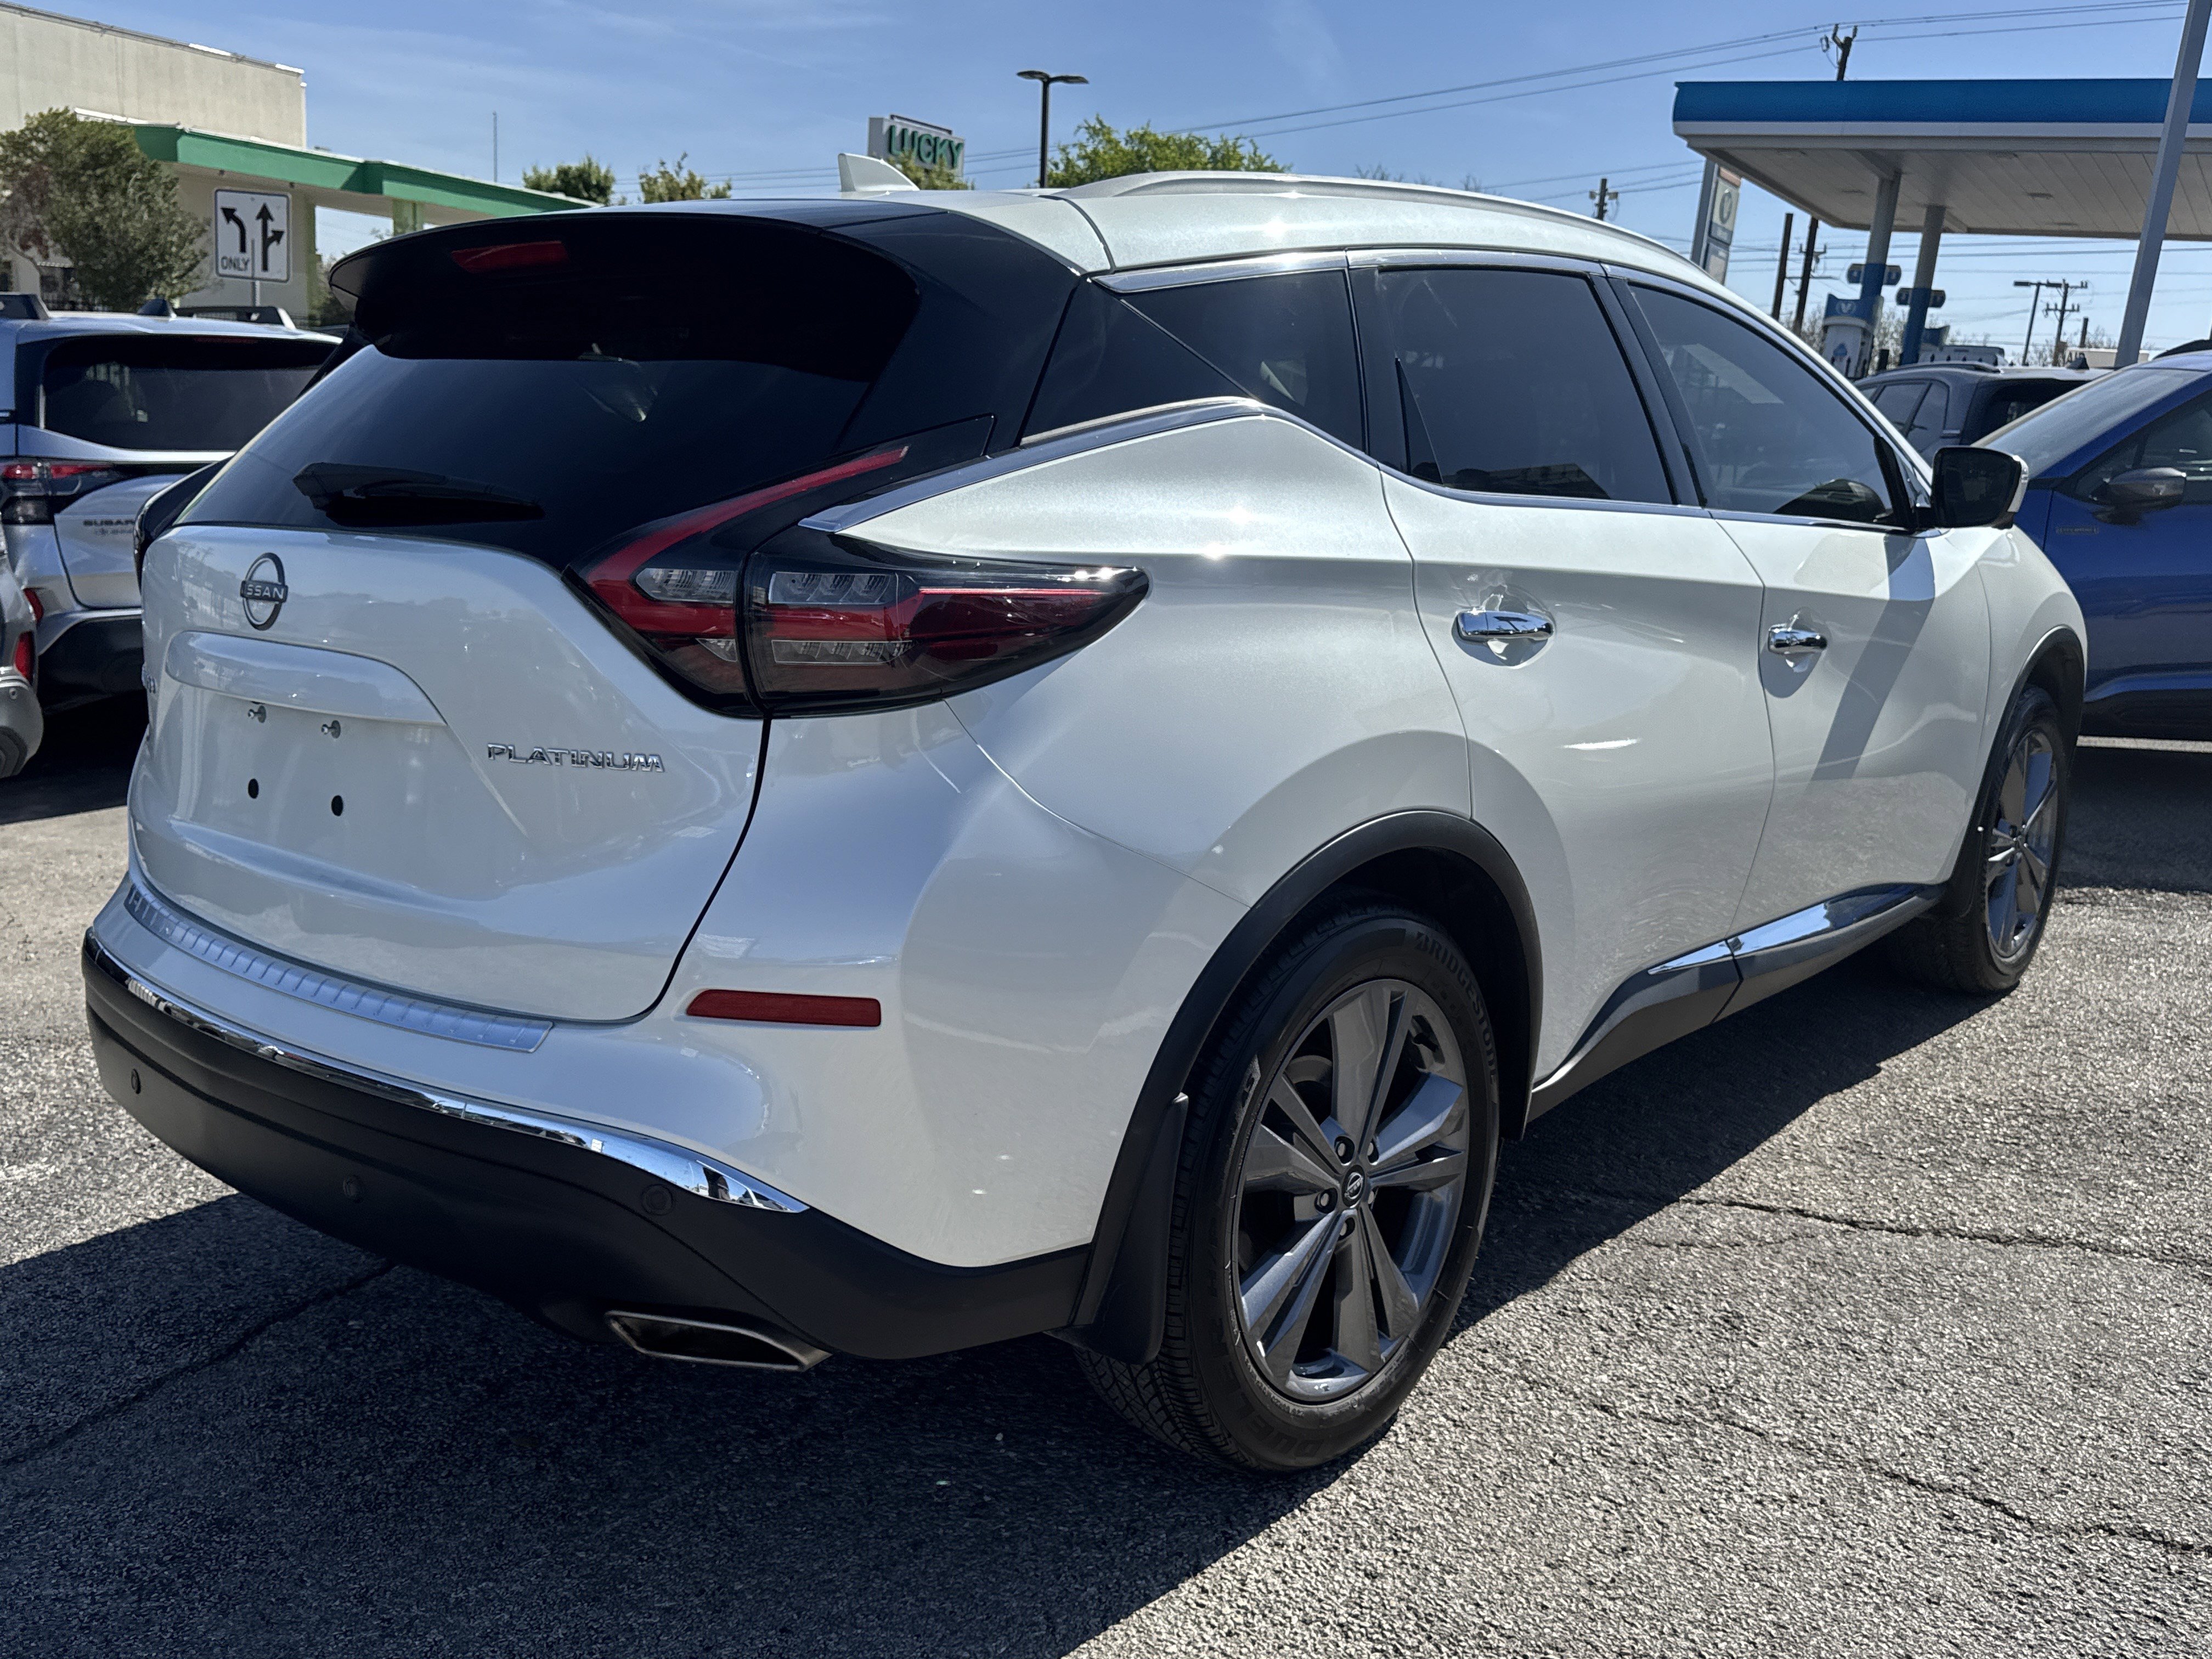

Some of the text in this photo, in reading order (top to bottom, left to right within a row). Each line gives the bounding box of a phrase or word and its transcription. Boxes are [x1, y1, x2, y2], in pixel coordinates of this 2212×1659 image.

[888, 125, 964, 170] LUCKY
[221, 256, 250, 272] ONLY
[487, 742, 665, 772] PLATINUM
[1414, 931, 1496, 1085] BRIDGESTONE
